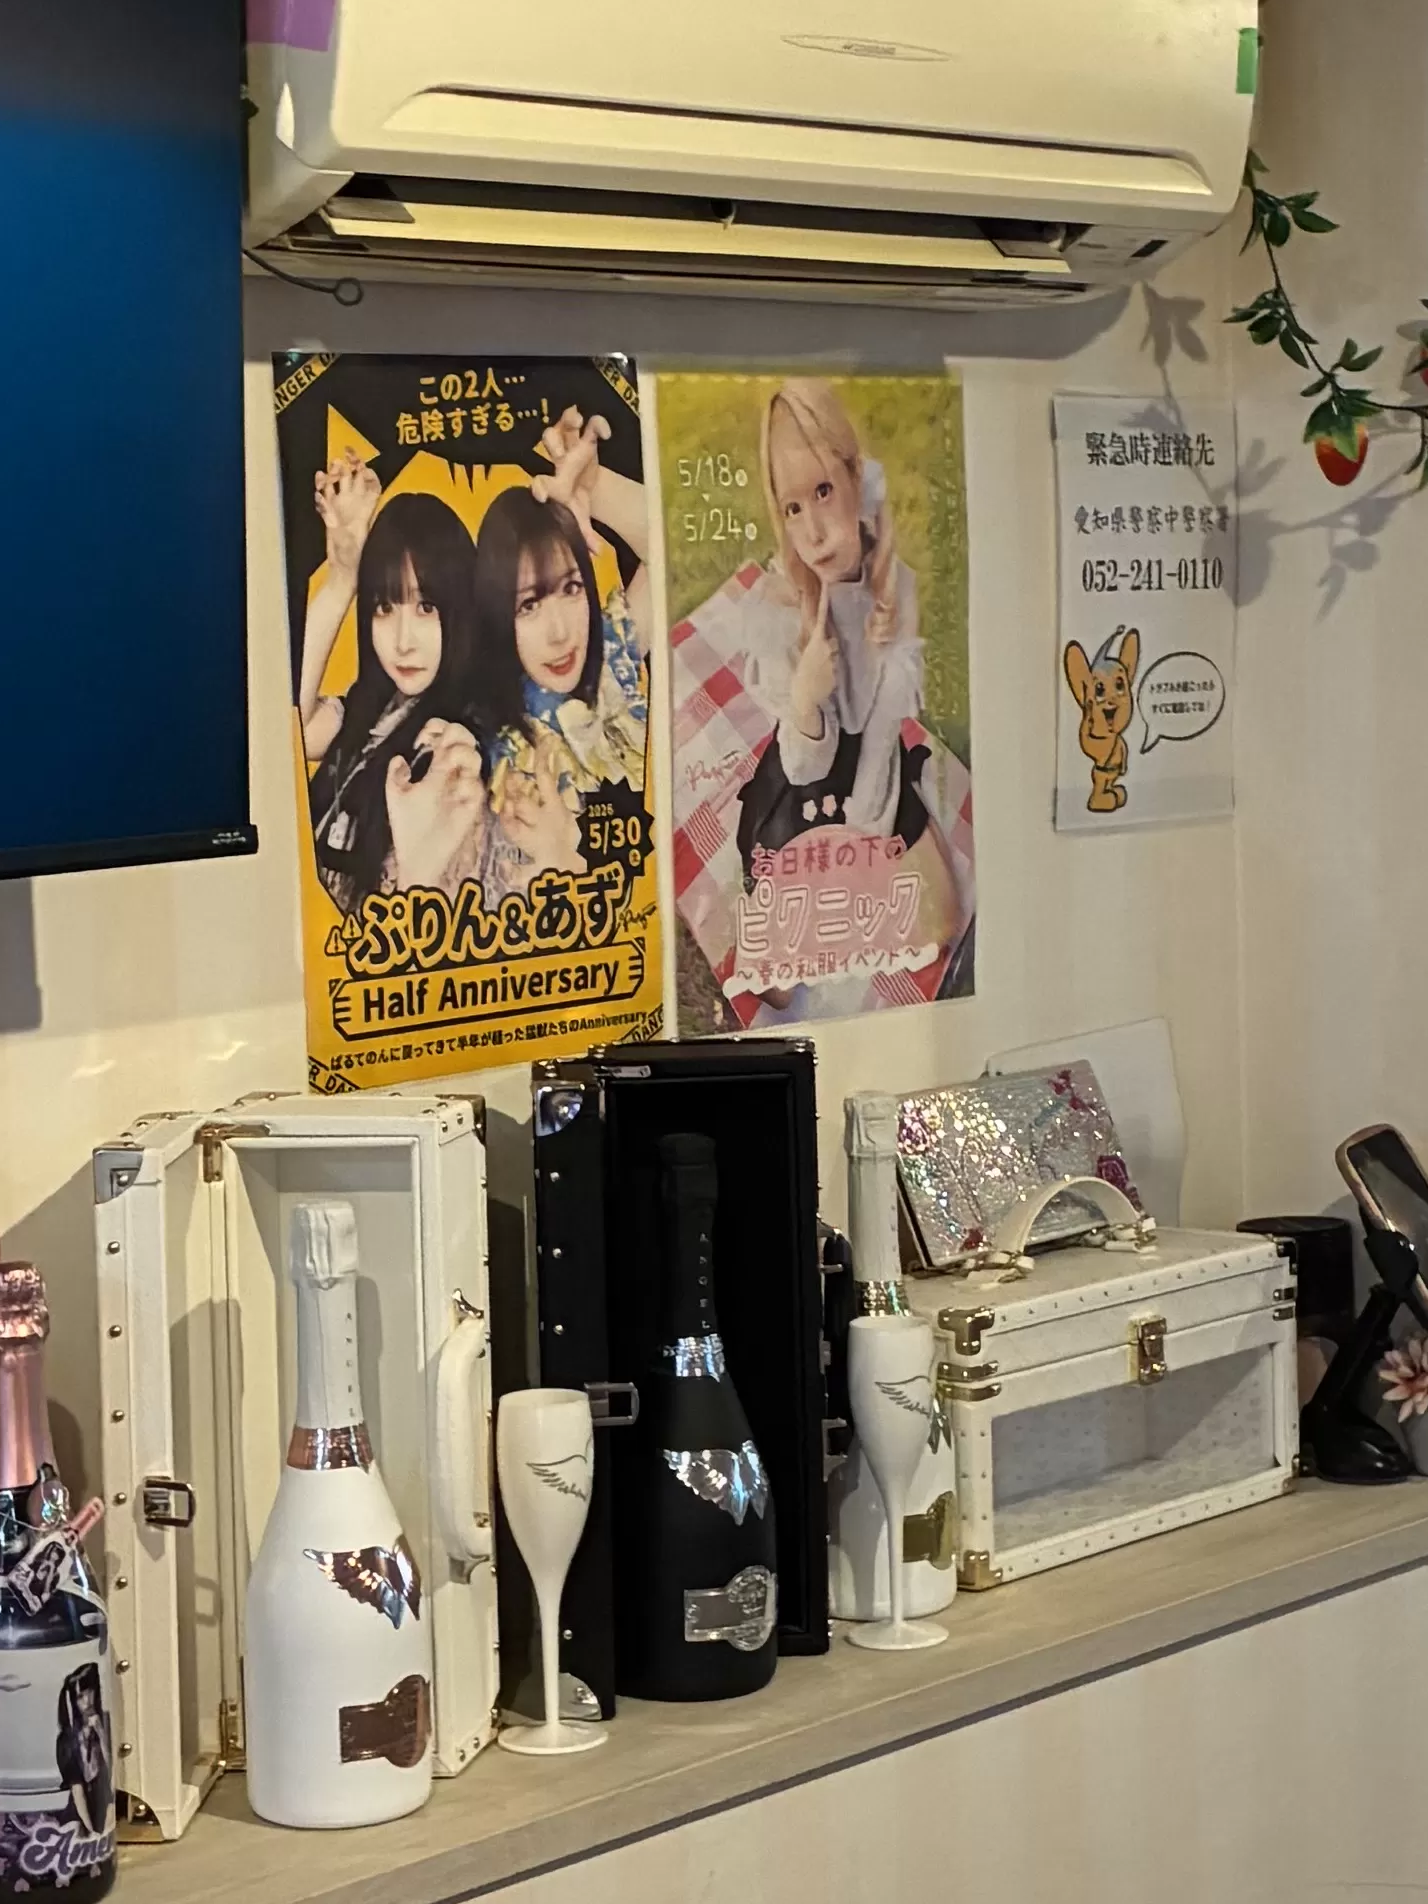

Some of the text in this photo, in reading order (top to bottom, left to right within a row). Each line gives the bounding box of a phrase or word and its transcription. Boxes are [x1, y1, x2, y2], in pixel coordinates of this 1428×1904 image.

[274, 364, 317, 410] NGER
[678, 453, 733, 487] 5/18
[1085, 432, 1215, 467] 緊急時連絡先
[684, 507, 743, 542] 5/24
[1081, 558, 1224, 592] 052-241-0110
[588, 815, 643, 856] 5/30
[751, 835, 907, 880] お日様の下の
[354, 865, 624, 968] ぷりん&あず
[737, 869, 922, 956] ピクニック
[362, 959, 622, 1023] Half Anniversary
